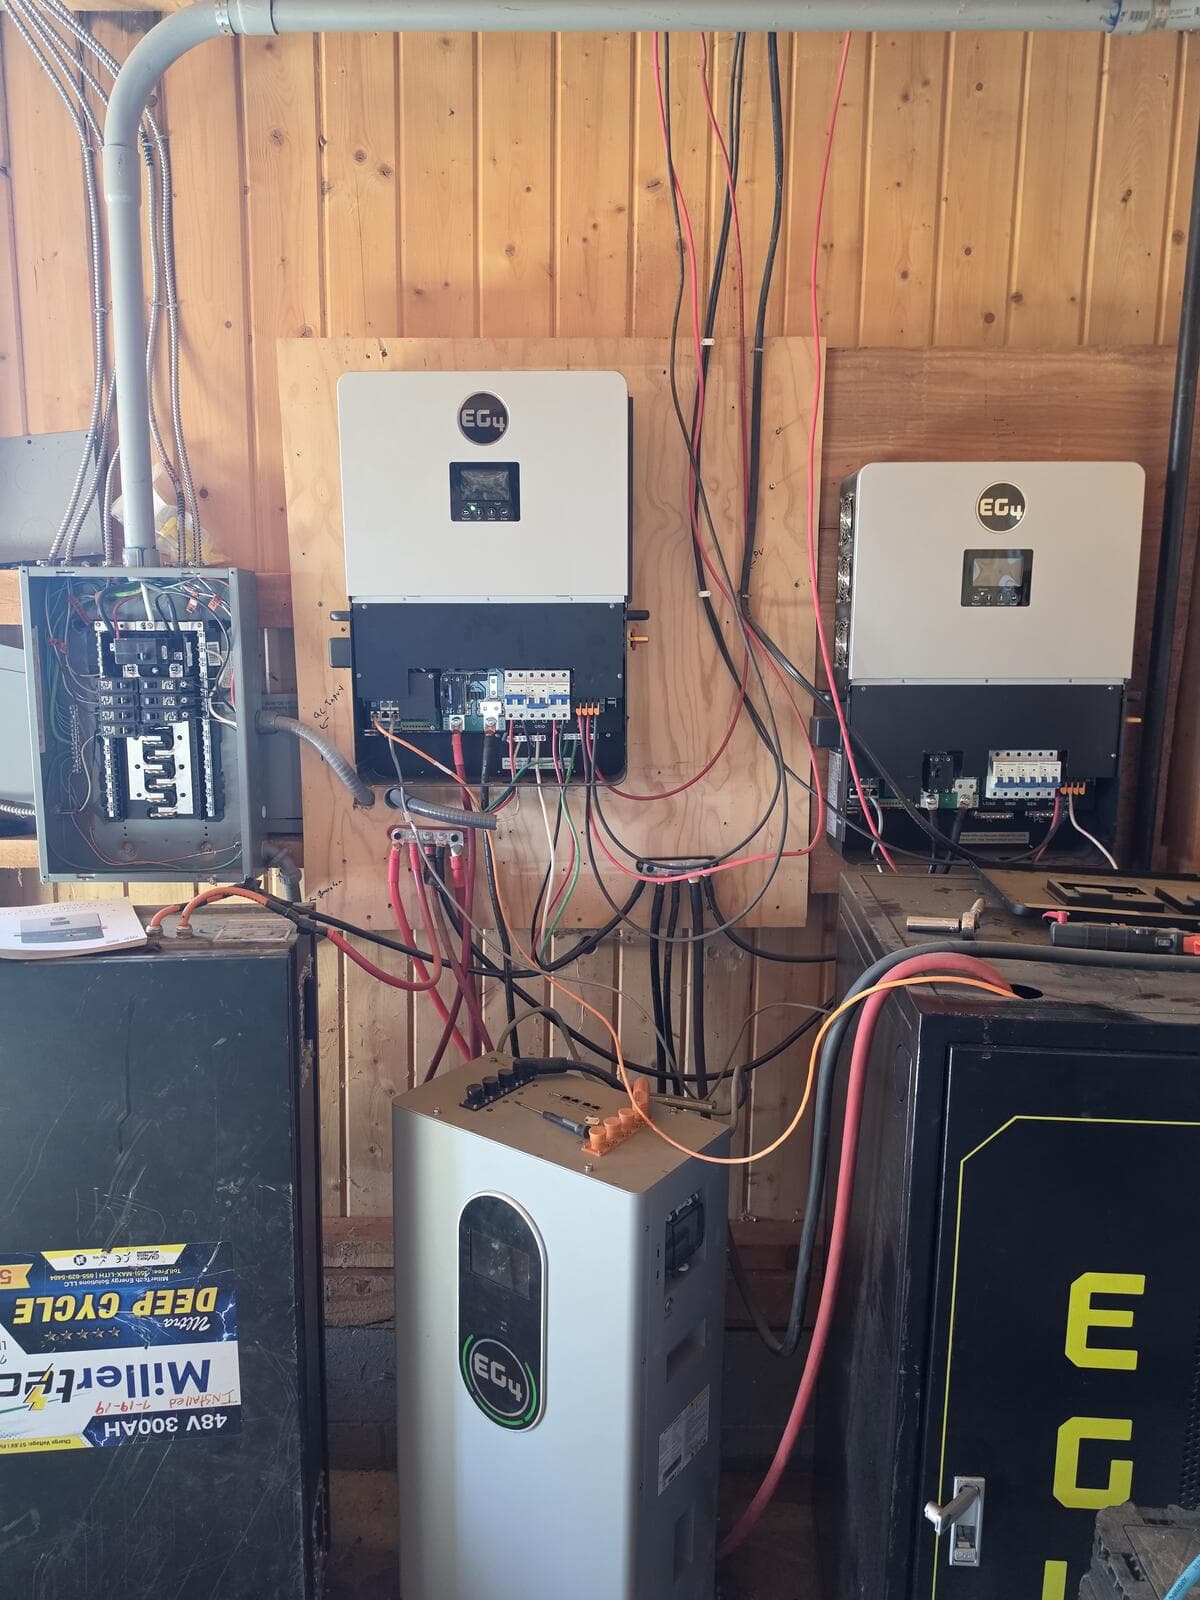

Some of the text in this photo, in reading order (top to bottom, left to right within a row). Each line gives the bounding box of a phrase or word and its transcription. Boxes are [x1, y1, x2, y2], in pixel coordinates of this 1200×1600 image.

[461, 409, 505, 432] EG4
[980, 498, 1022, 520] EG4
[12, 1287, 218, 1324] DEEP CYCLE
[163, 1316, 211, 1331] Ultra
[474, 1352, 522, 1402] EG4
[104, 1413, 227, 1437] 48V 300AH
